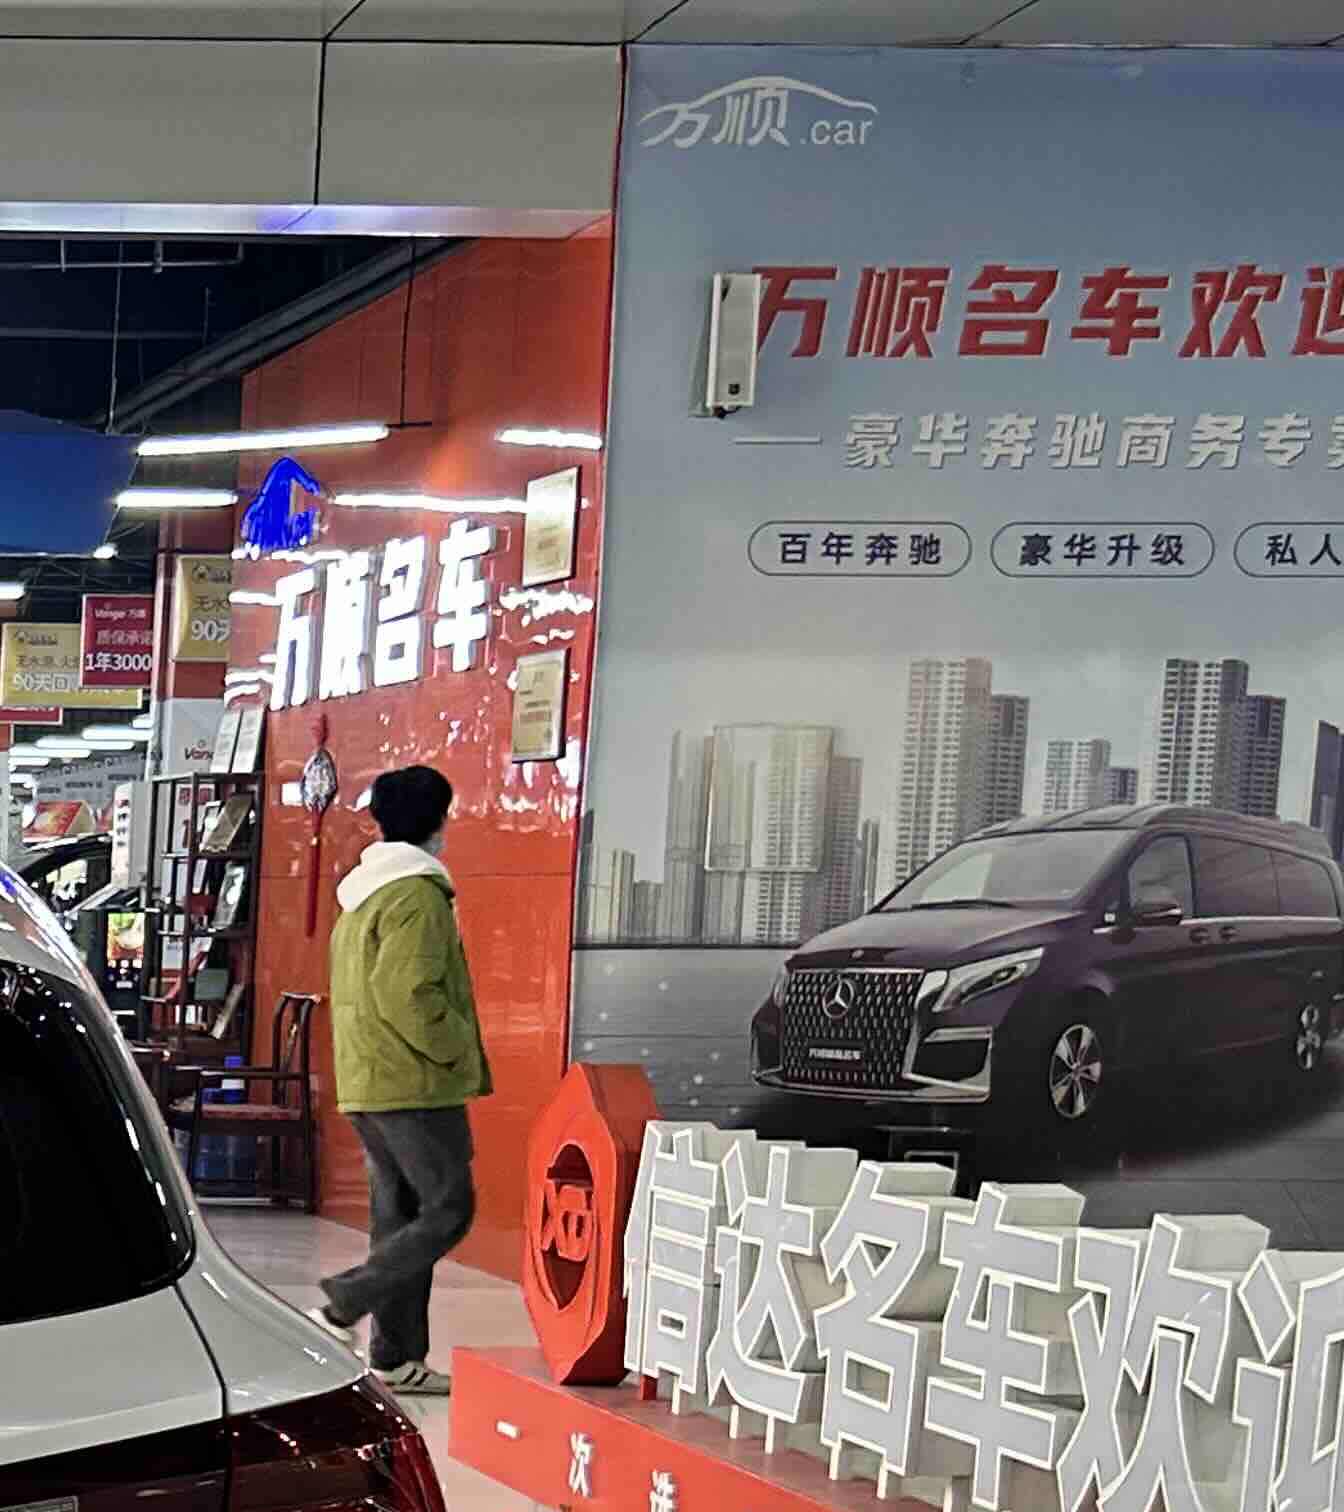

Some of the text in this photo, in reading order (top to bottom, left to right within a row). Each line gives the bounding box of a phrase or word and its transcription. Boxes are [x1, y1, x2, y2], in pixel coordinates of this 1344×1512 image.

[640, 78, 791, 149] 万顺
[842, 411, 1344, 469] 豪华奔驰商务专
[778, 531, 944, 567] 百年奔驰
[1018, 533, 1185, 568] 豪华升级
[269, 518, 496, 711] 万顺名车
